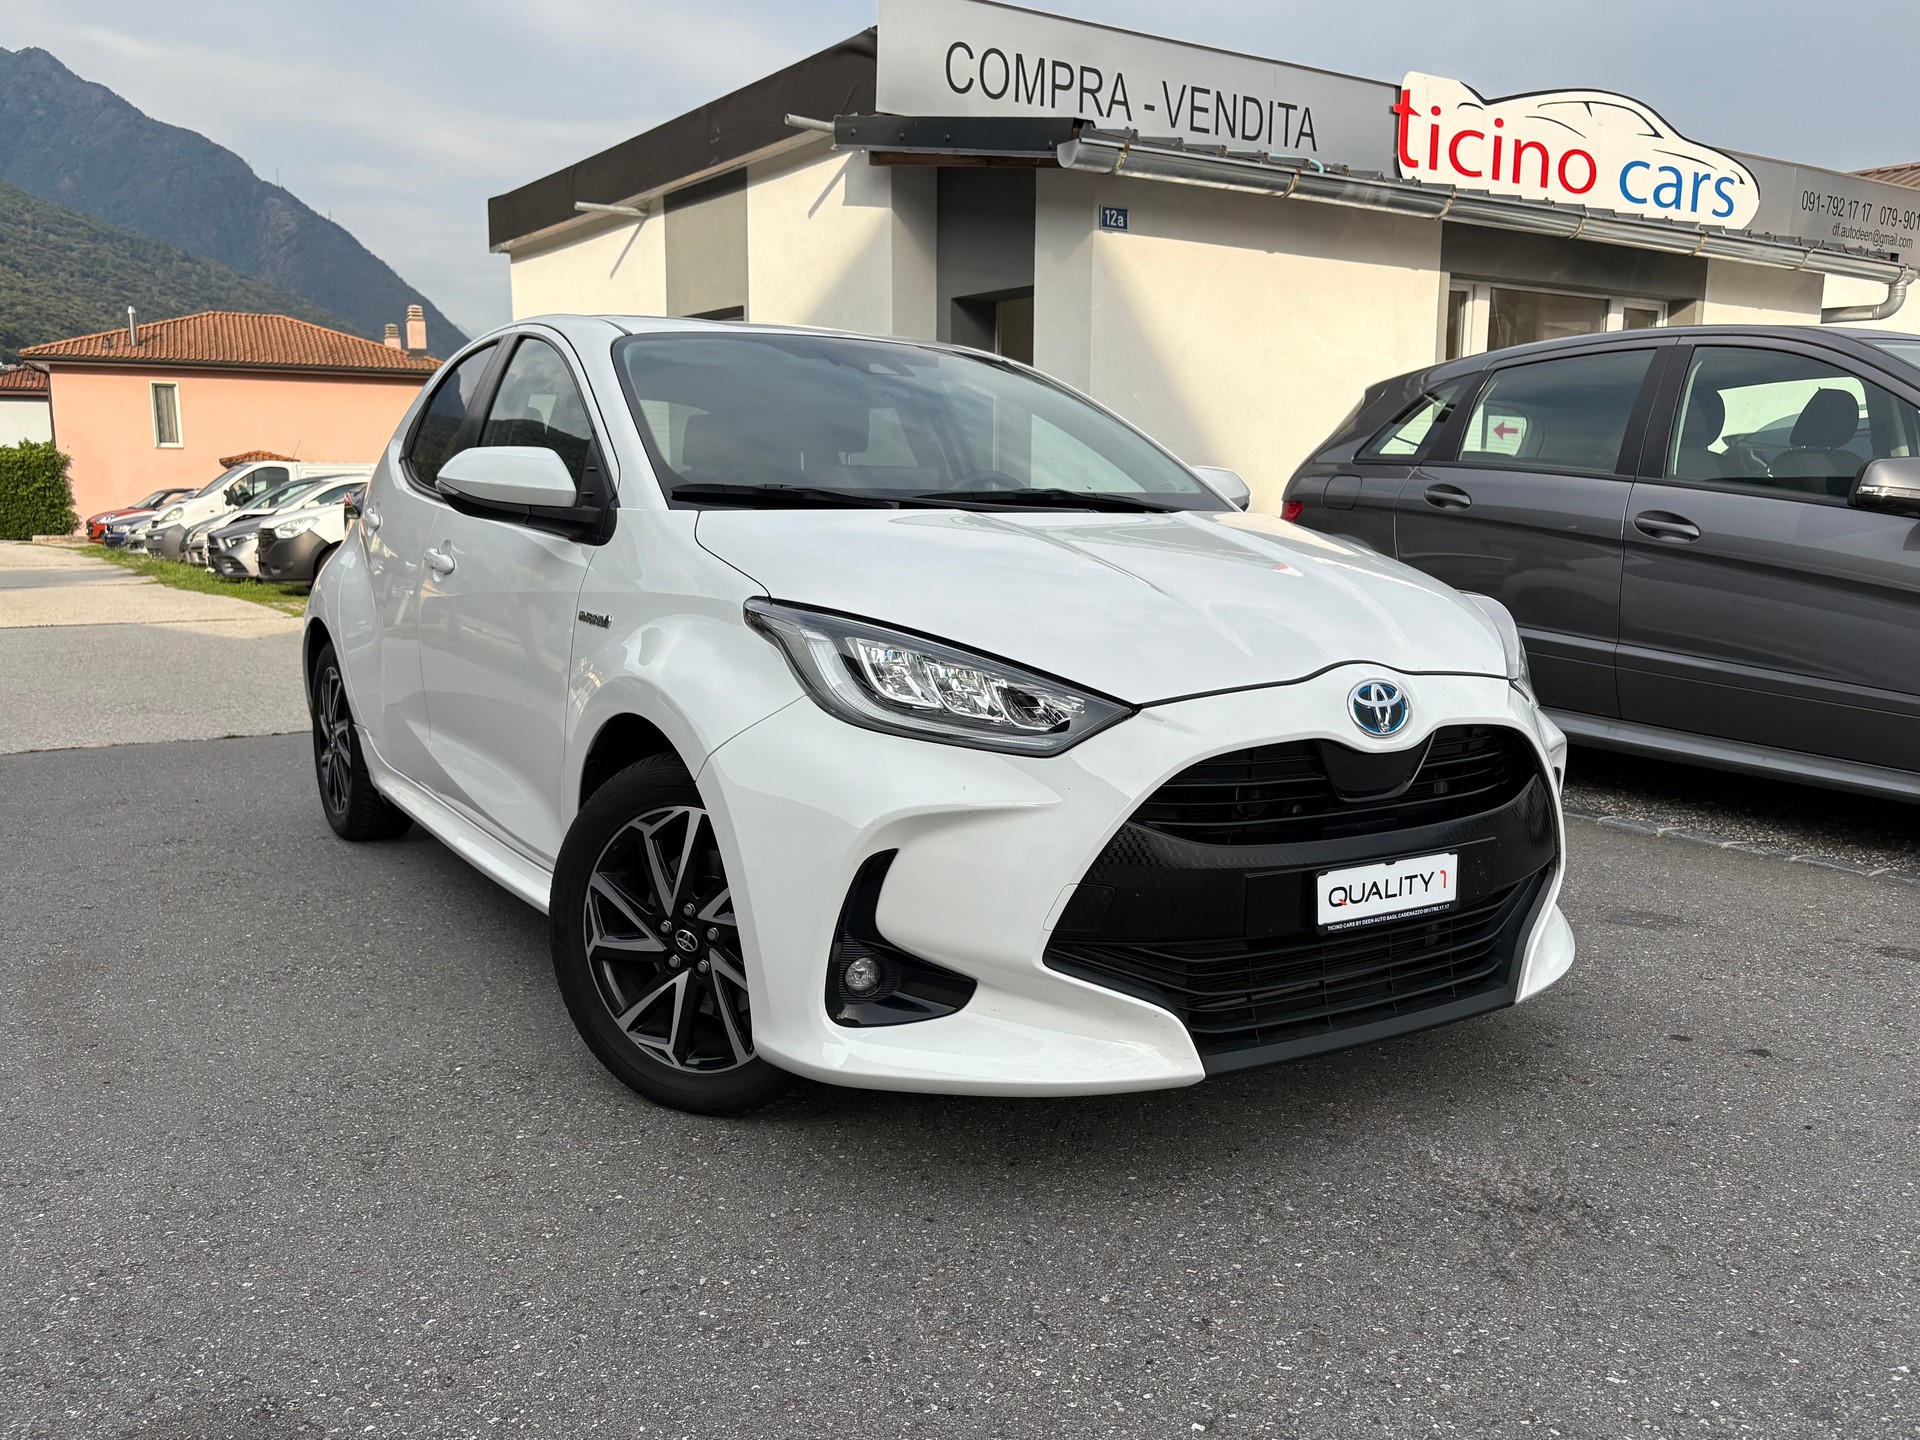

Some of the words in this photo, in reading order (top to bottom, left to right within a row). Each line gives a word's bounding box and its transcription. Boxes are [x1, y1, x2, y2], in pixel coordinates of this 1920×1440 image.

[946, 41, 1133, 121] COMPRA
[1393, 88, 1597, 194] ticino
[1619, 160, 1736, 218] cars
[1801, 190, 1845, 217] 091-792
[1105, 210, 1125, 227] 12a
[1832, 222, 1914, 249] df.autodeen@gmail.com
[1328, 871, 1435, 908] QUALITY
[1374, 915, 1387, 923] AUTO
